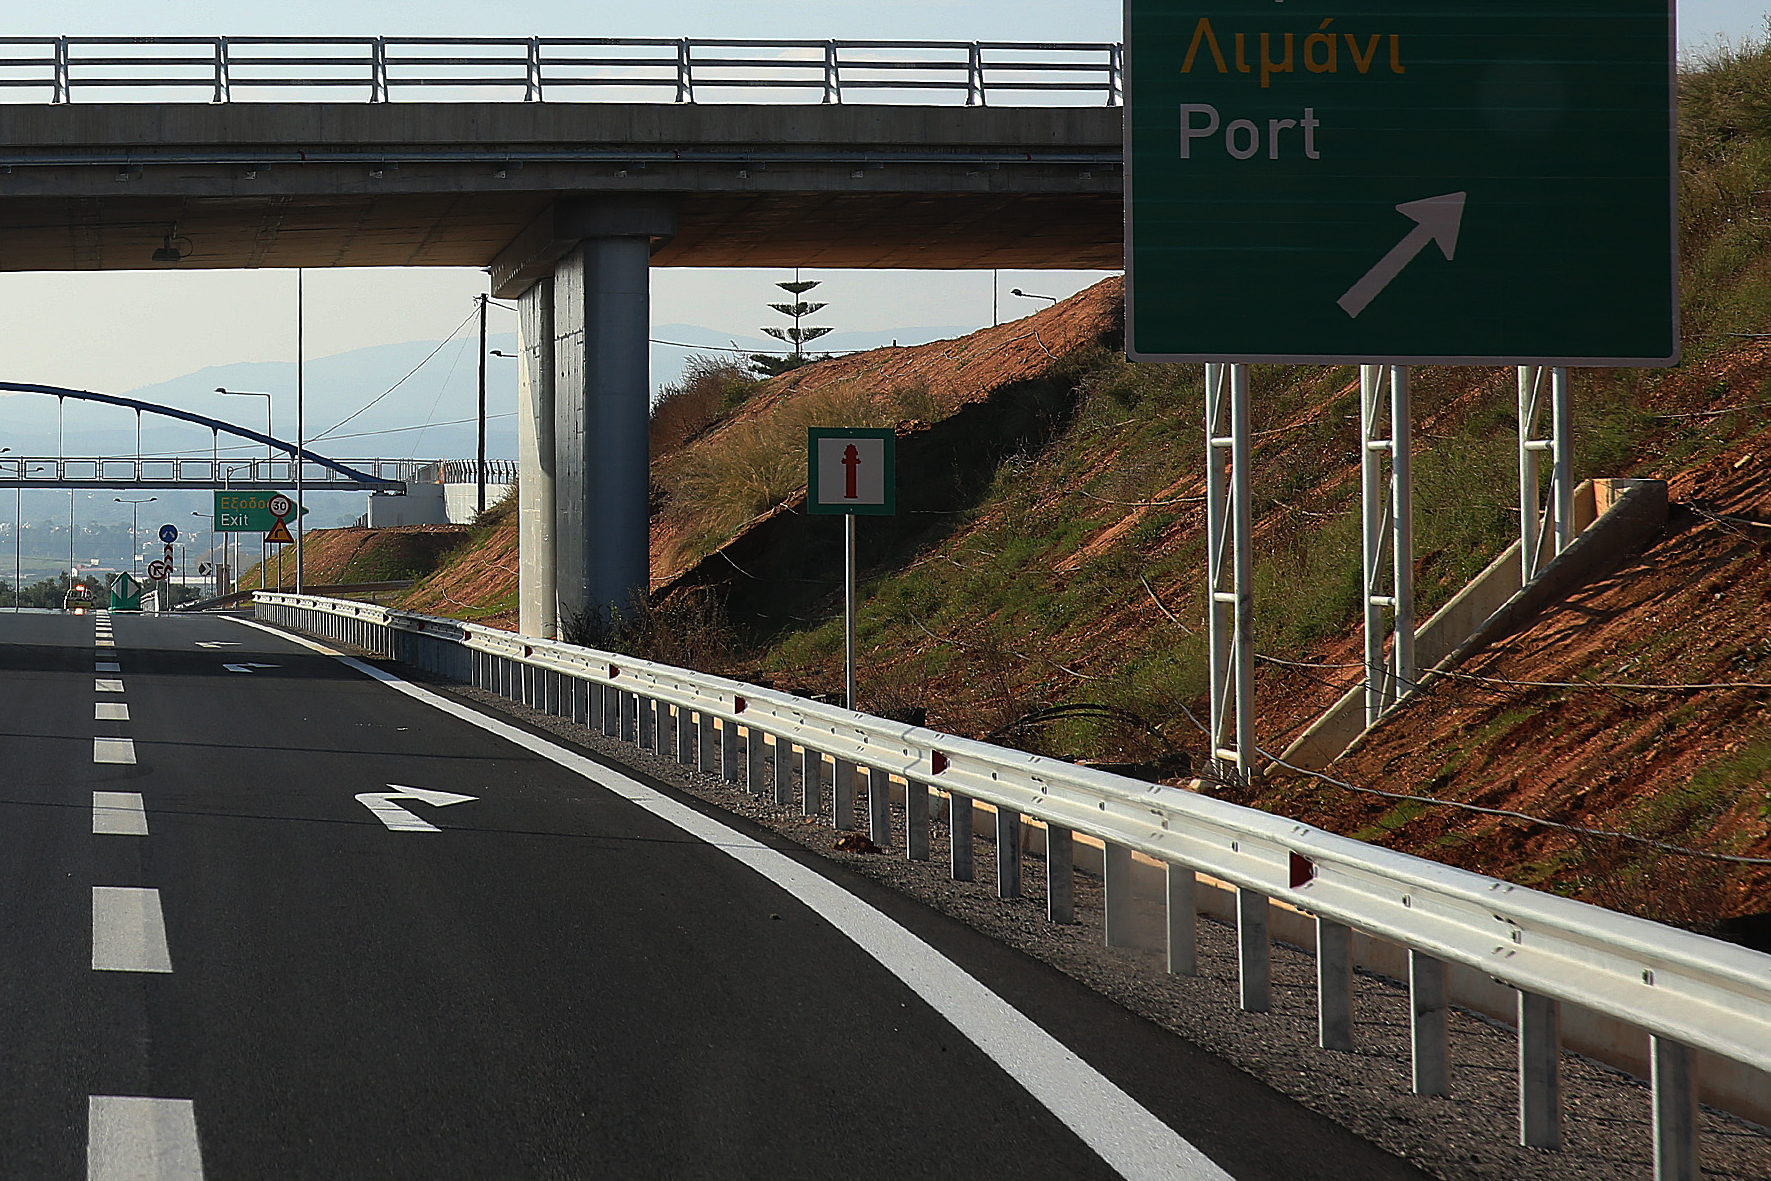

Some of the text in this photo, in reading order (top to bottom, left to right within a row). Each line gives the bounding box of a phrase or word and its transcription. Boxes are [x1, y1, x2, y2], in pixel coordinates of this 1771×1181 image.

[1180, 18, 1406, 88] Λιμάνι
[1179, 103, 1321, 160] Port
[221, 513, 249, 526] Exit
[273, 501, 287, 511] 30
